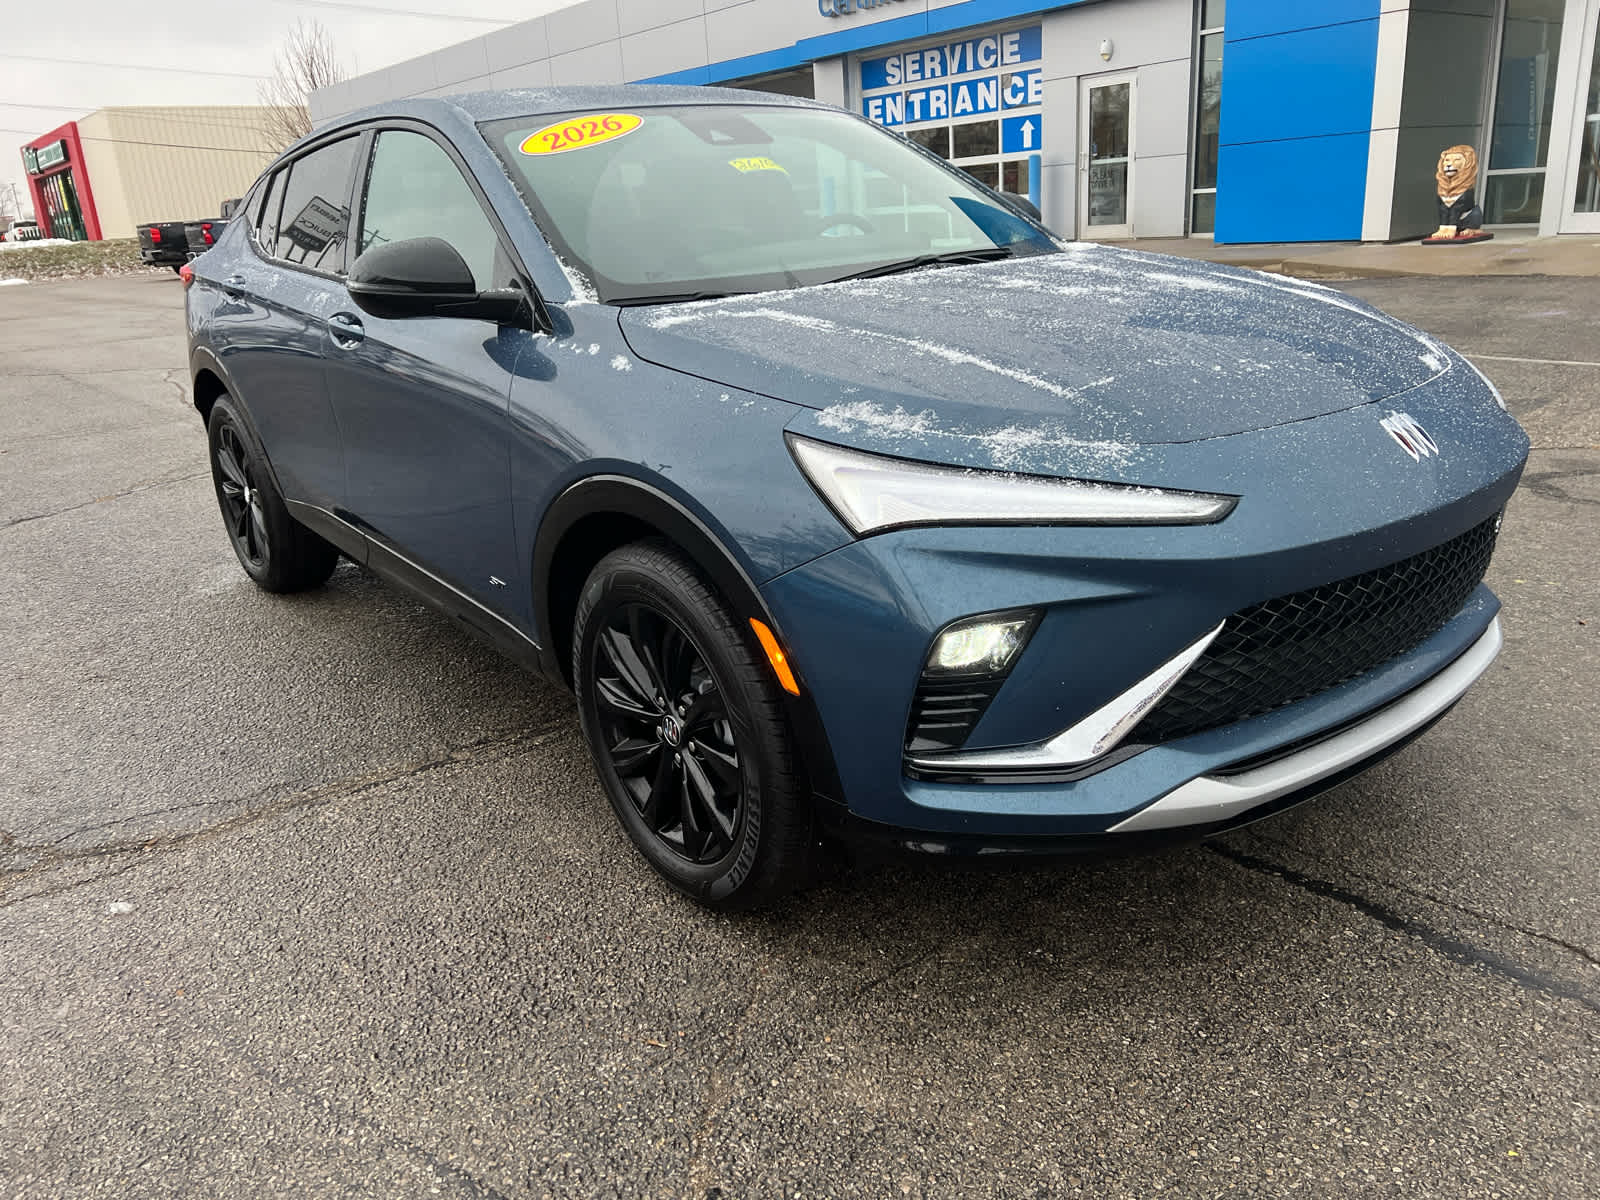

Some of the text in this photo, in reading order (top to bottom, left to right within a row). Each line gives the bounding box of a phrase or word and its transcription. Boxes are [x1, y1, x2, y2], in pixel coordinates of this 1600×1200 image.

[885, 33, 1021, 85] SERVICE
[868, 73, 1042, 125] ENTRANCE
[541, 115, 623, 151] 2026
